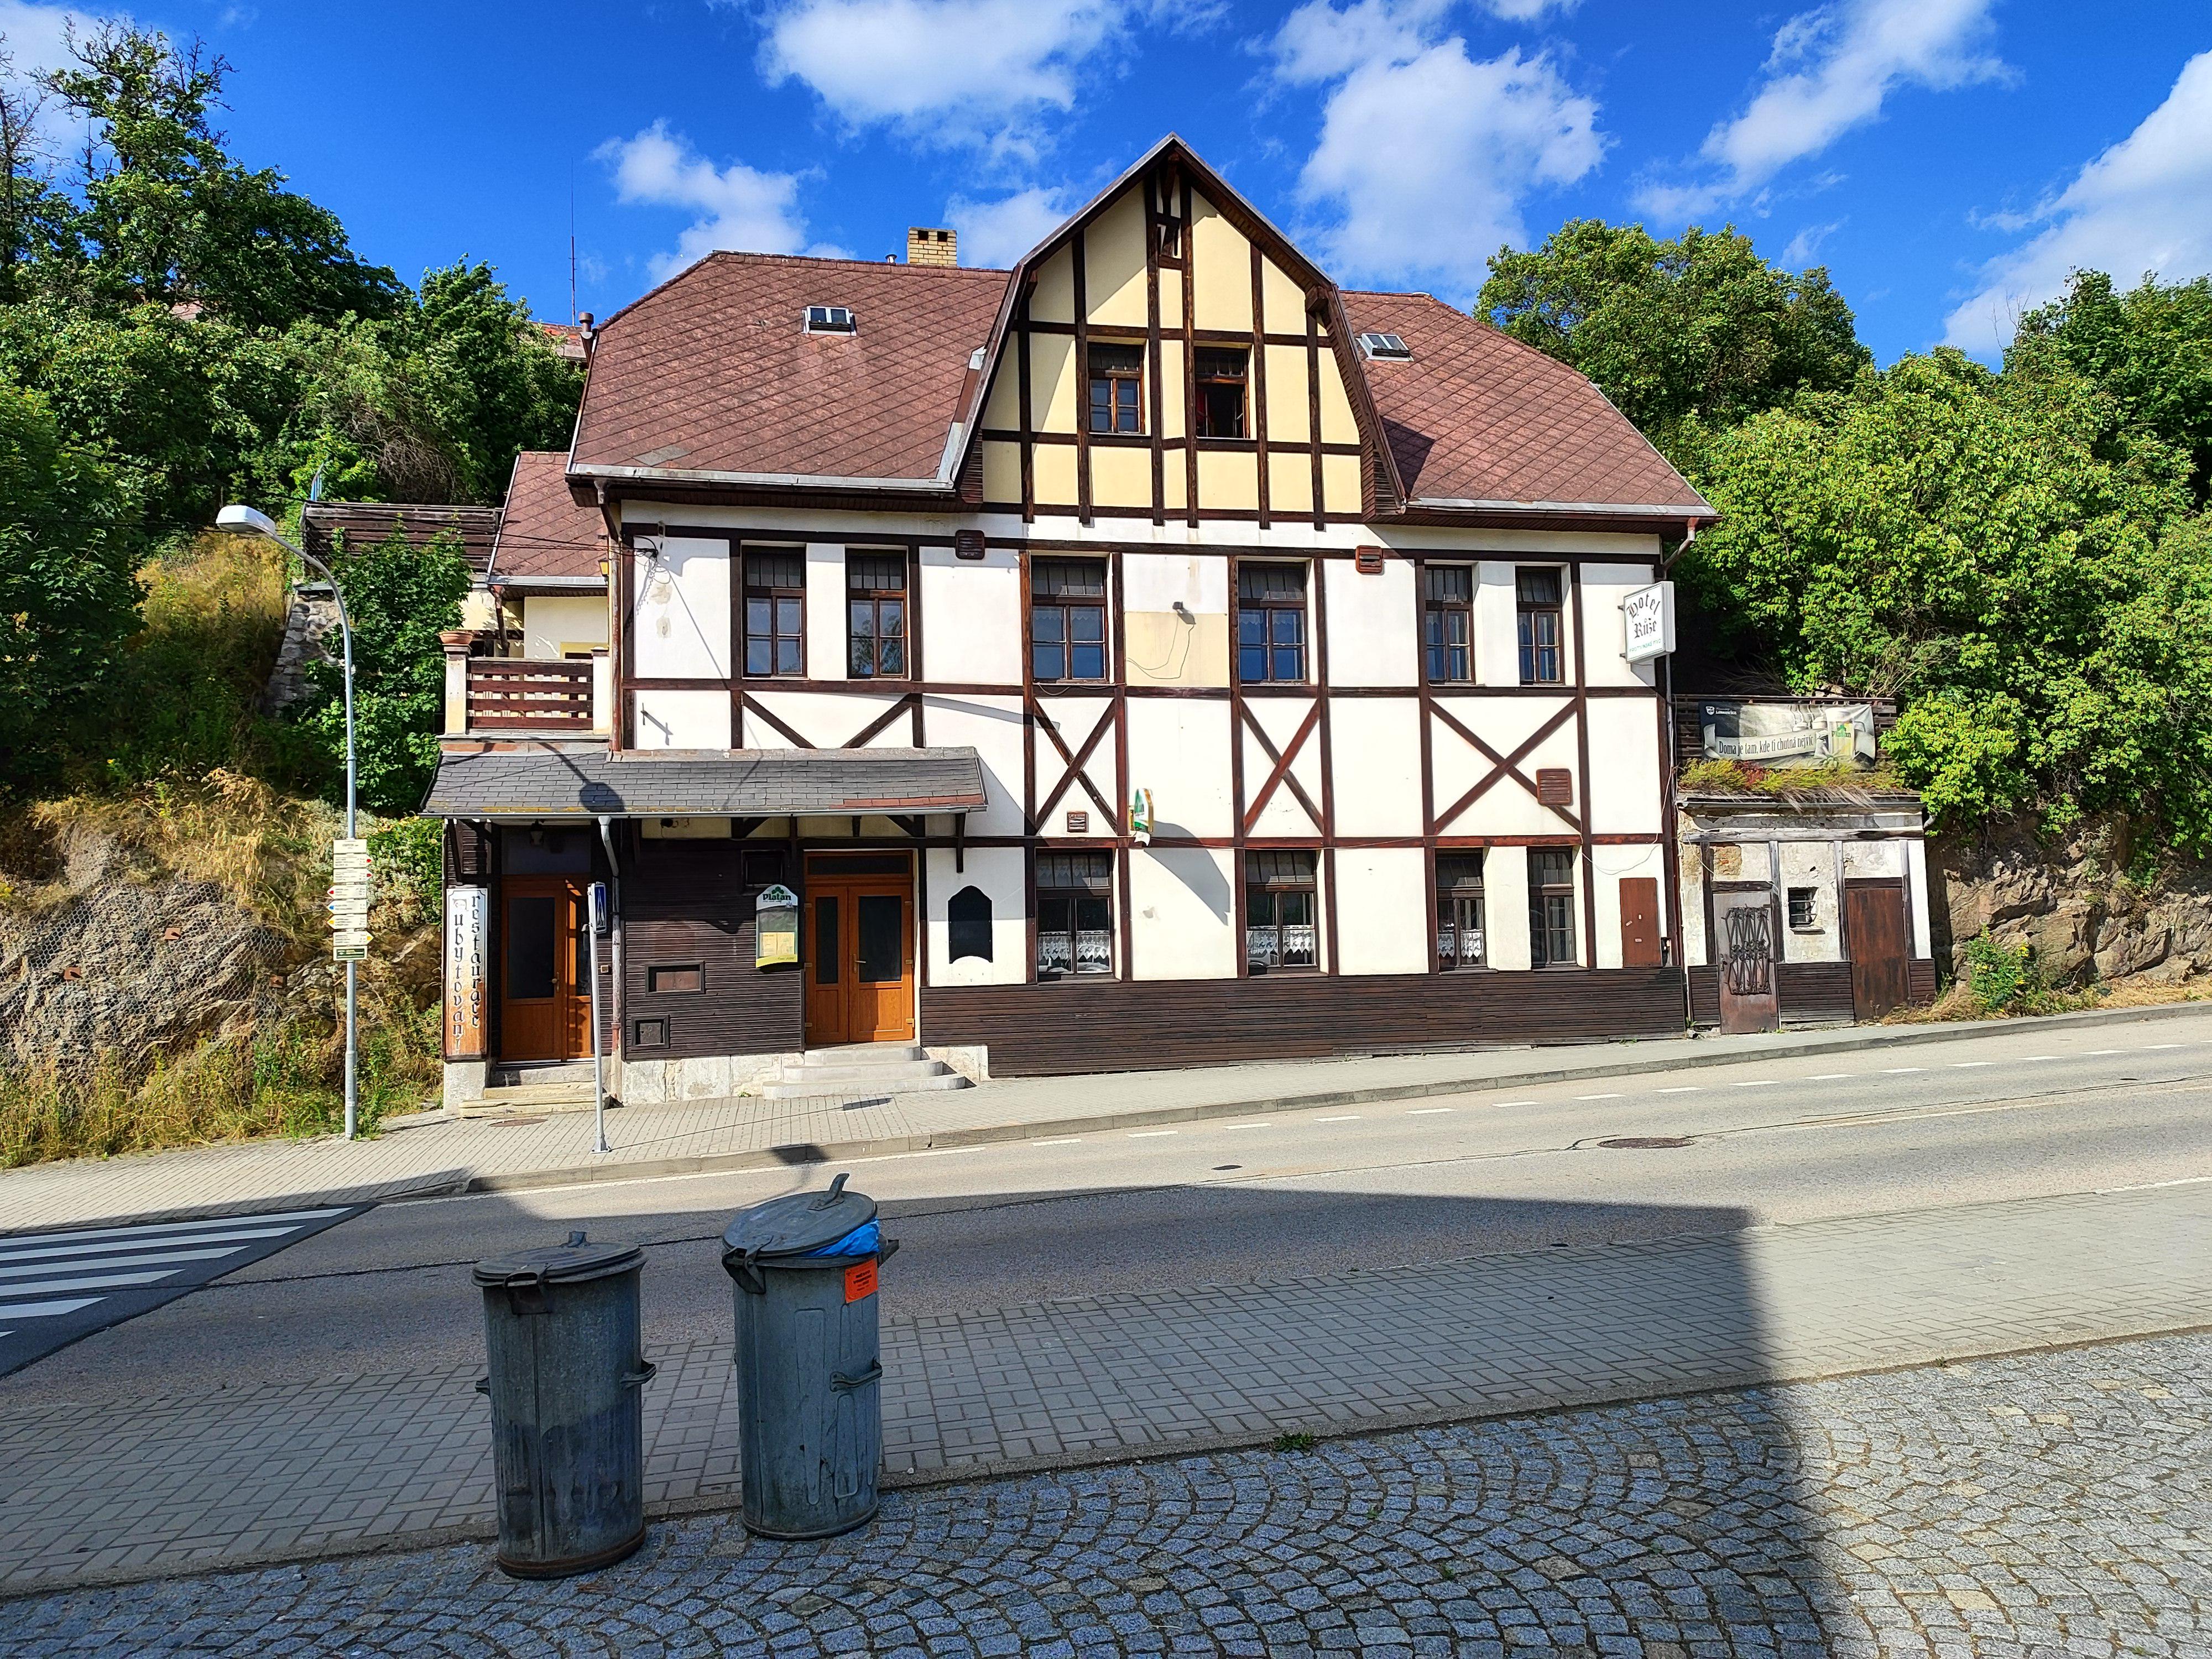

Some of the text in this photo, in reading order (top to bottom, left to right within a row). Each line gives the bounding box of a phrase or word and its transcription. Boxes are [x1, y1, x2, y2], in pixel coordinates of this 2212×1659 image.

[1626, 592, 1661, 623] Hotel
[1634, 618, 1657, 639] Růže
[1719, 735, 1813, 756] Doma je tam, kde ti chutná nejvíc
[471, 895, 481, 1027] restaurace
[453, 914, 463, 1050] ubytování
